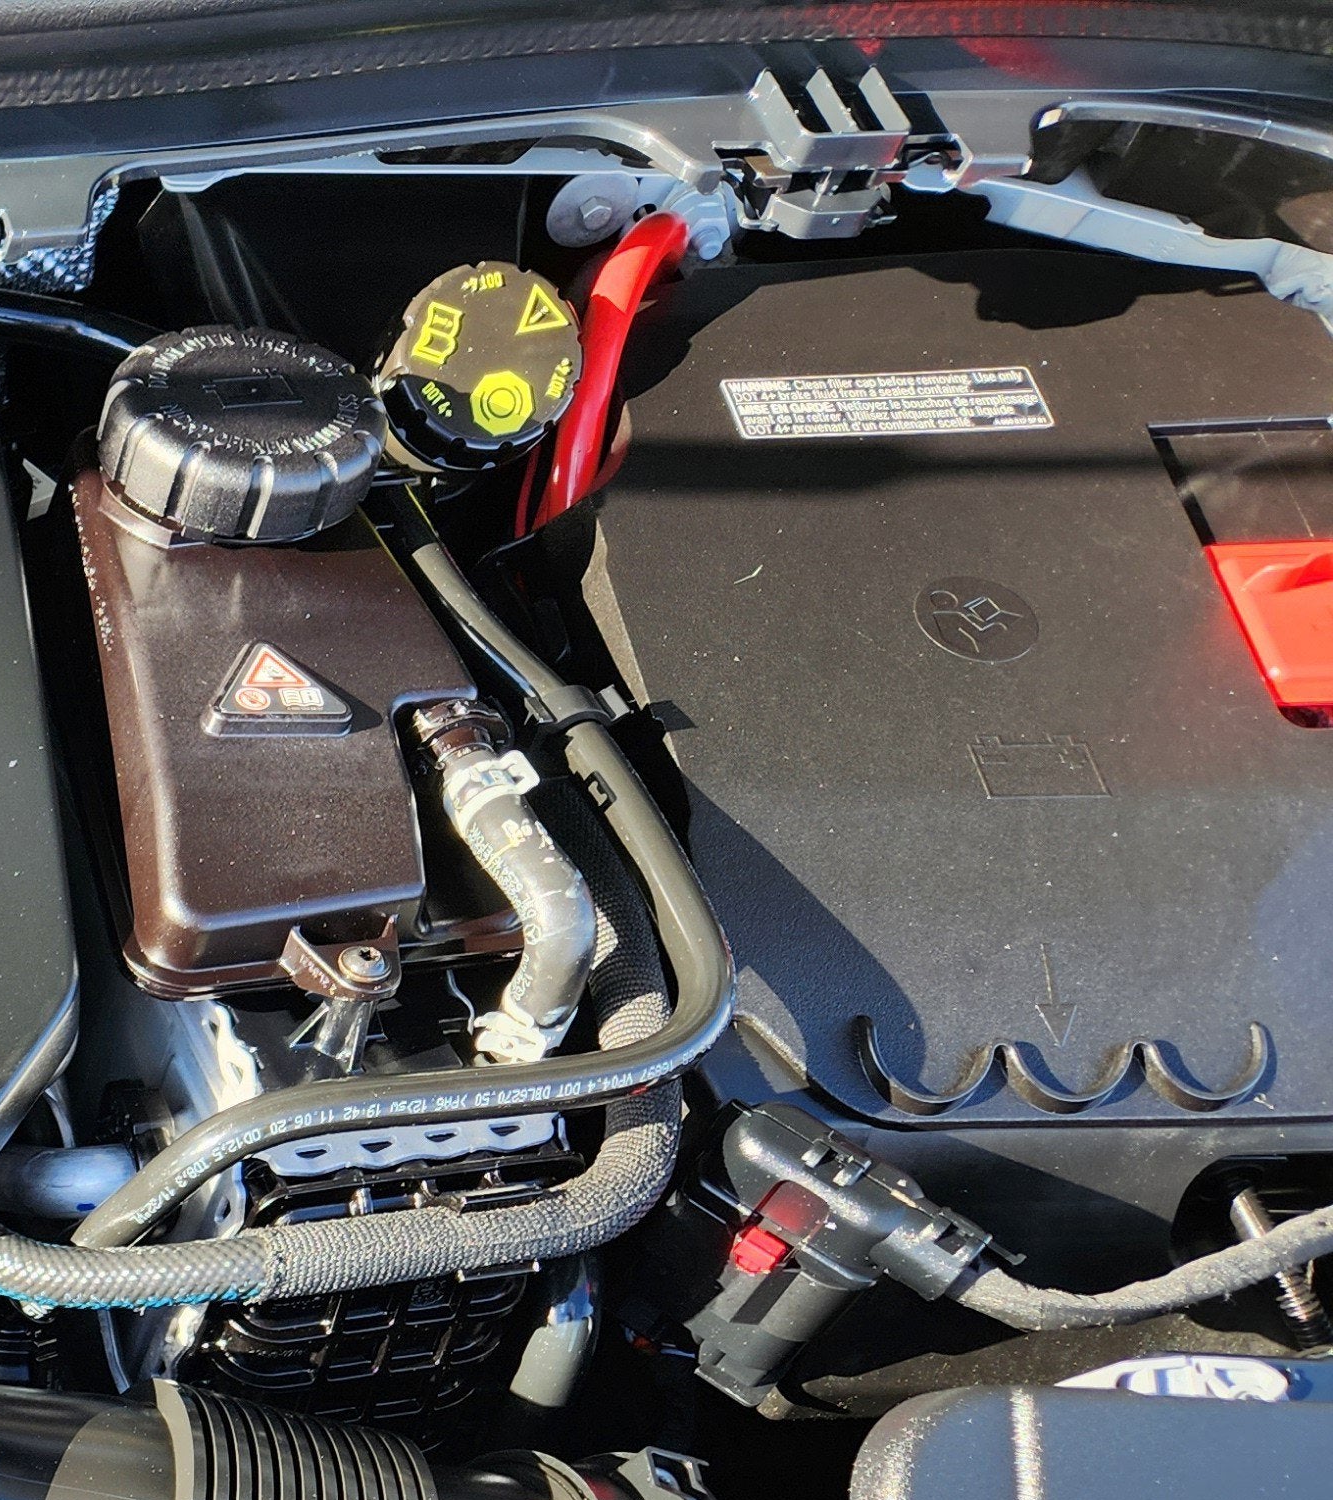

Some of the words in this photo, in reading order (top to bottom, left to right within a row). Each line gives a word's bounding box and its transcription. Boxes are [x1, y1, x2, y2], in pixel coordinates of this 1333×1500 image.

[728, 381, 791, 393] WARNING:
[793, 379, 827, 391] Clean
[828, 378, 853, 390] filler
[855, 378, 877, 390] cap
[879, 375, 915, 387] before
[973, 371, 994, 383] Use
[997, 370, 1024, 383] only
[421, 381, 445, 406] DOT
[733, 392, 757, 402] DOT
[761, 391, 777, 401] 4+
[778, 390, 811, 400] brake
[813, 389, 838, 399] fluid
[839, 388, 867, 398] from
[878, 386, 914, 397] sealed
[917, 383, 974, 396] container.
[737, 404, 769, 415] MISE
[771, 403, 789, 414] EN
[789, 402, 836, 413] GARDE:
[837, 400, 889, 412] Nettoyez
[890, 399, 901, 409] le
[902, 398, 952, 410] bouchon
[953, 396, 968, 407] de
[969, 393, 1039, 407] remplissage
[744, 415, 775, 425] avant
[777, 413, 792, 424] de
[794, 413, 805, 423] le
[806, 412, 845, 423] retirer.
[846, 410, 889, 422] Utilisez
[890, 407, 958, 420] uniquement
[959, 406, 974, 417] du
[975, 405, 1016, 418] liquide
[746, 425, 772, 435] DOT
[774, 424, 791, 434] 4+
[792, 422, 850, 435] provenant
[851, 421, 877, 432] d'un
[878, 418, 937, 431] contenant
[557, 1081, 581, 1098] DOT
[269, 1105, 334, 1136] 11.06.20
